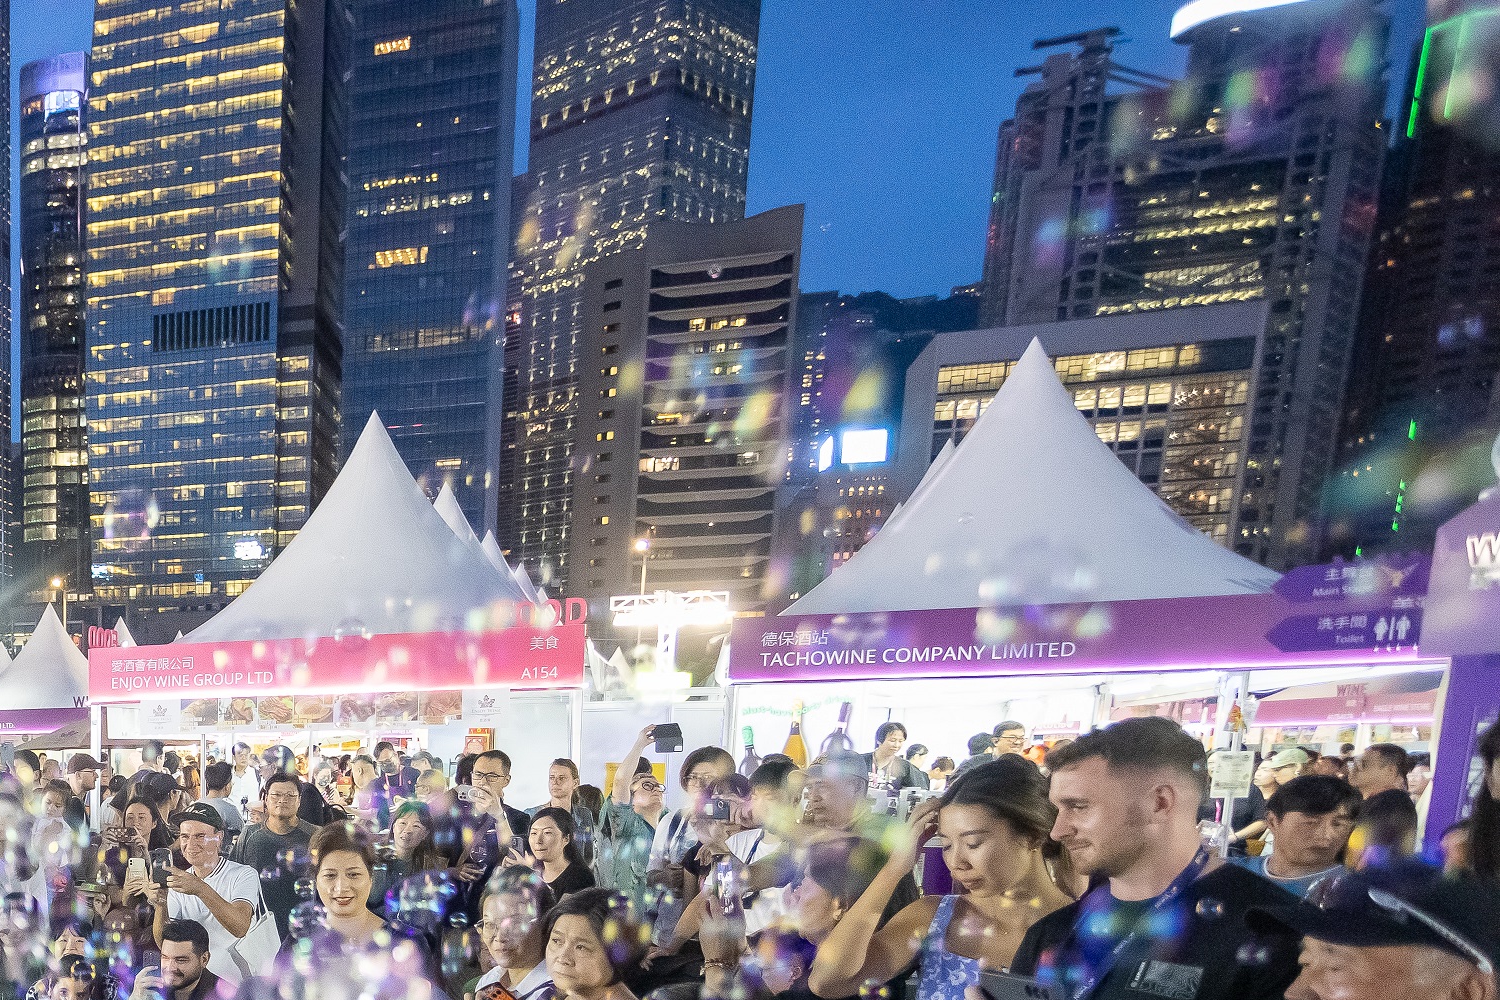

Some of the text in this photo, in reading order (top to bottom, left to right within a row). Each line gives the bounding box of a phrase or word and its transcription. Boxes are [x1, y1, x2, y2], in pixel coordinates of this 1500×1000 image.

[515, 597, 588, 626] OOD
[1317, 615, 1367, 630] 洗手間
[529, 635, 559, 651] 美食
[761, 630, 829, 647] 德保酒站
[1335, 634, 1364, 643] Toilet
[759, 641, 1076, 667] TACHOWINE COMPANY LIMITED
[111, 656, 194, 673] 愛酒薈有限公司
[521, 666, 558, 680] A154
[111, 671, 273, 691] ENJOY WINE GROUP LTD
